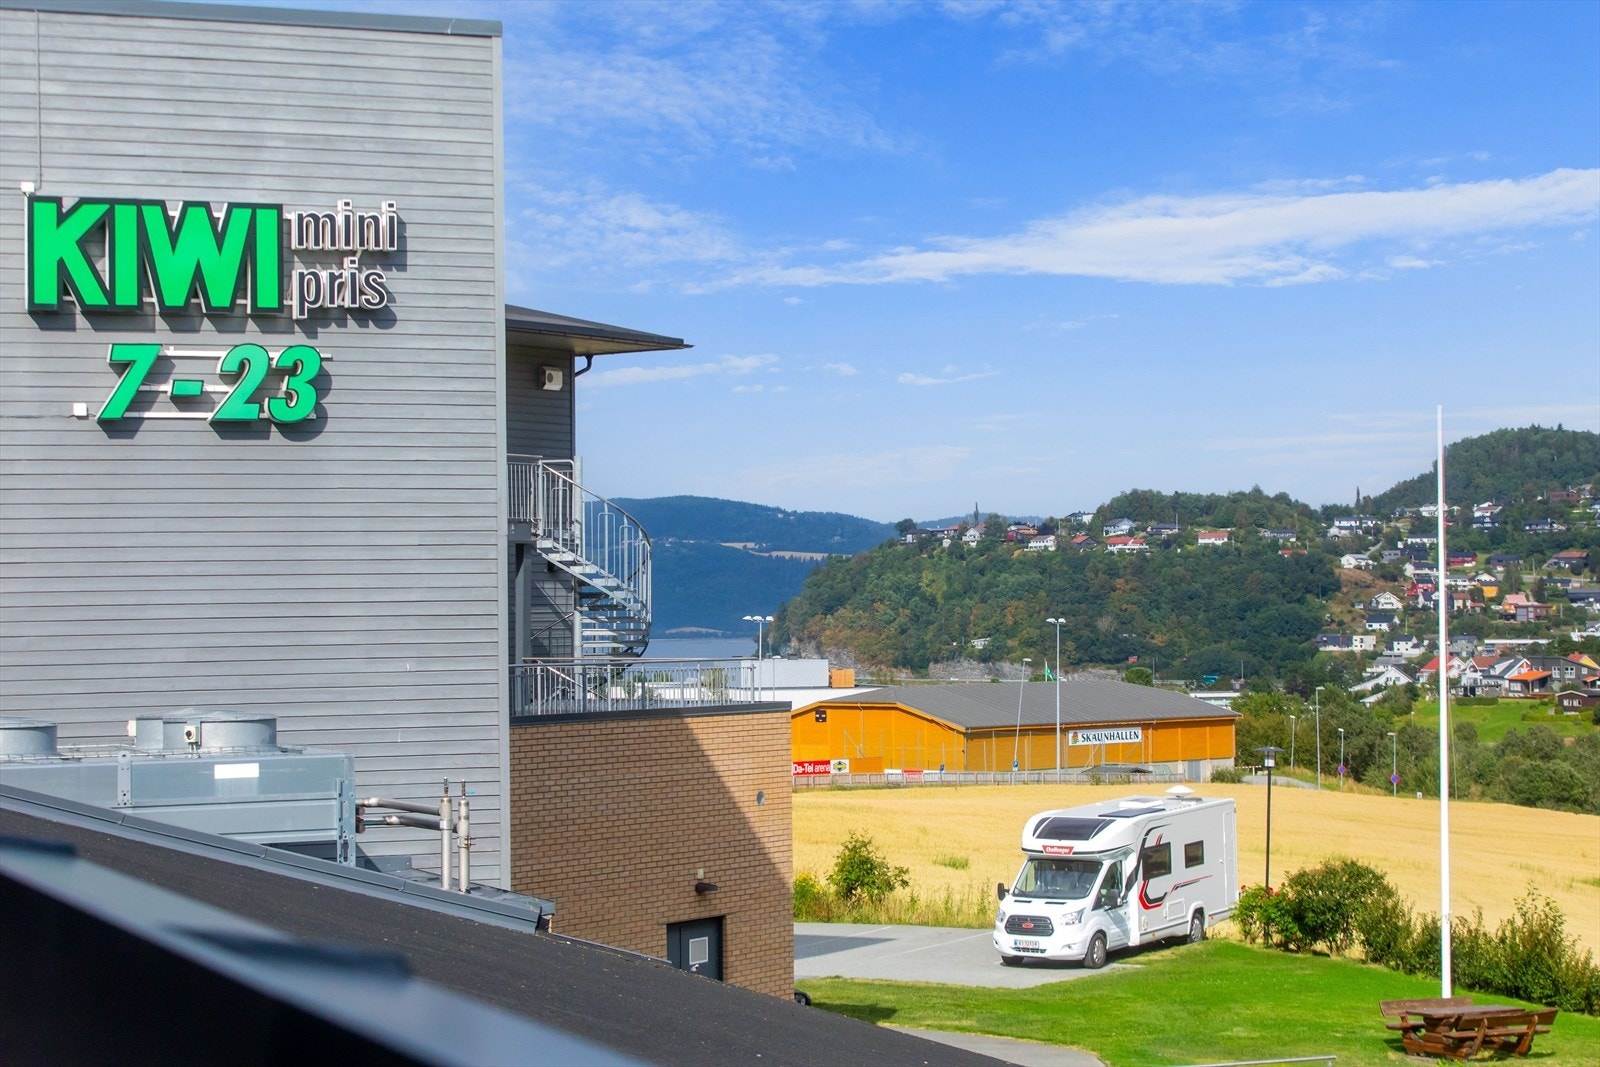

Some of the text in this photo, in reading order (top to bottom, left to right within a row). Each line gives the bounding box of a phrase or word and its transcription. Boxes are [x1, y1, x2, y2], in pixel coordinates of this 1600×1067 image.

[291, 199, 398, 251] mini
[27, 196, 284, 314] KIWI
[292, 257, 388, 320] pris
[1081, 730, 1139, 743] SKAUNHALLEN
[793, 763, 831, 773] Da-Tel arena
